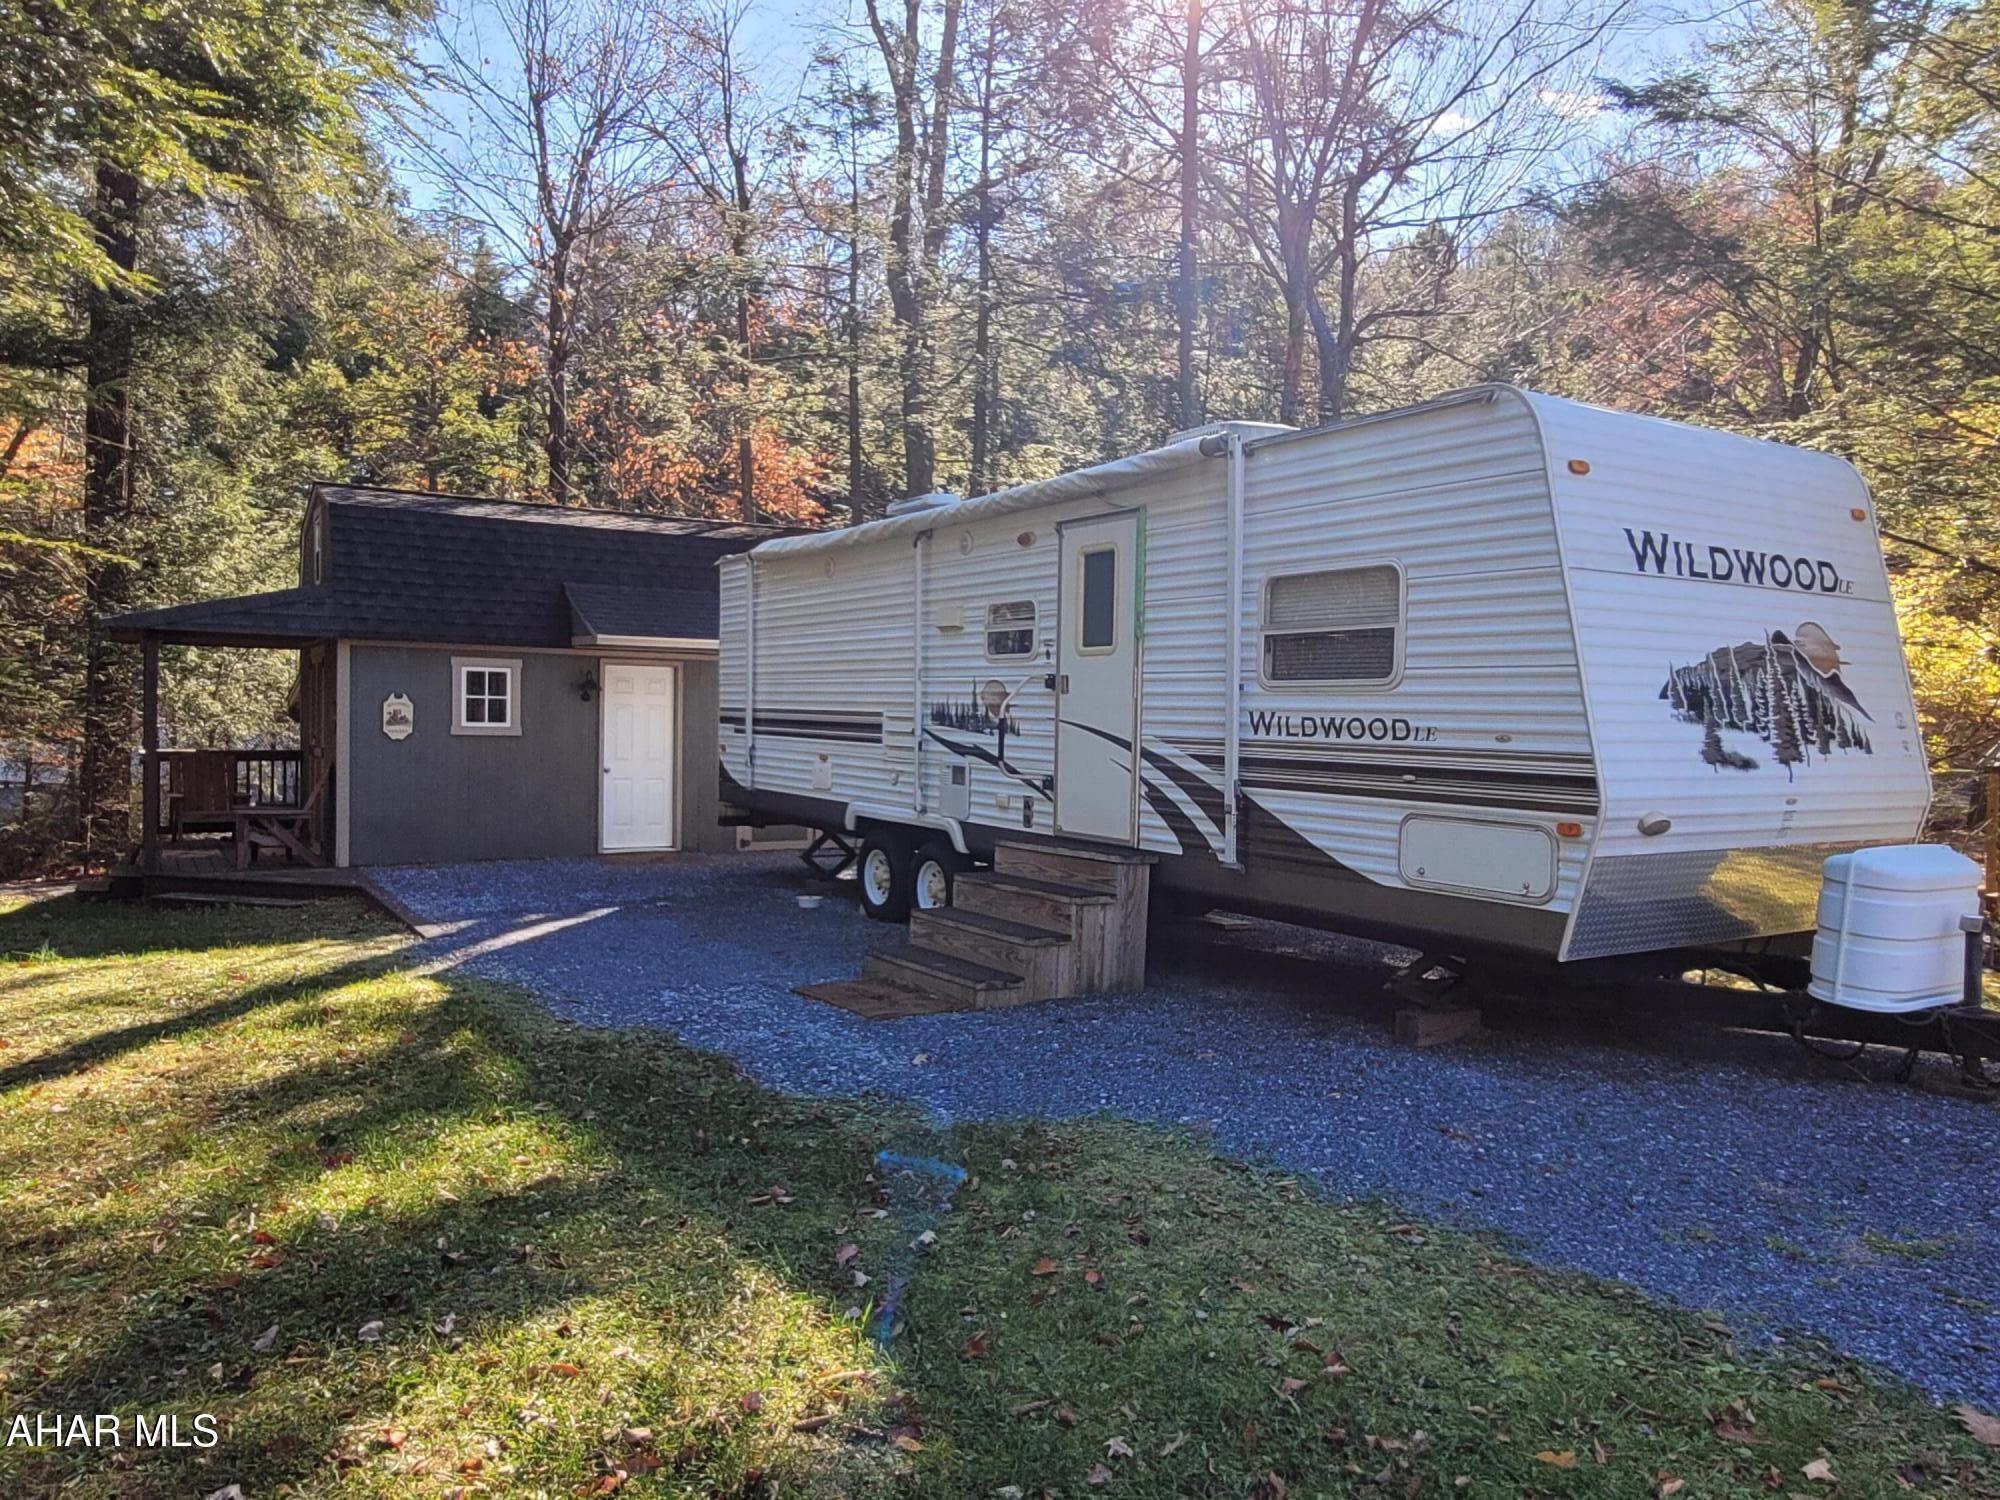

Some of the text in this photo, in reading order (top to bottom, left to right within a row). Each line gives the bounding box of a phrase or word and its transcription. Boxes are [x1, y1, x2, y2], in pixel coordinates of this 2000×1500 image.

[1622, 527, 1854, 595] WILDWOOD LE
[1248, 711, 1438, 742] WILDWOOD LE
